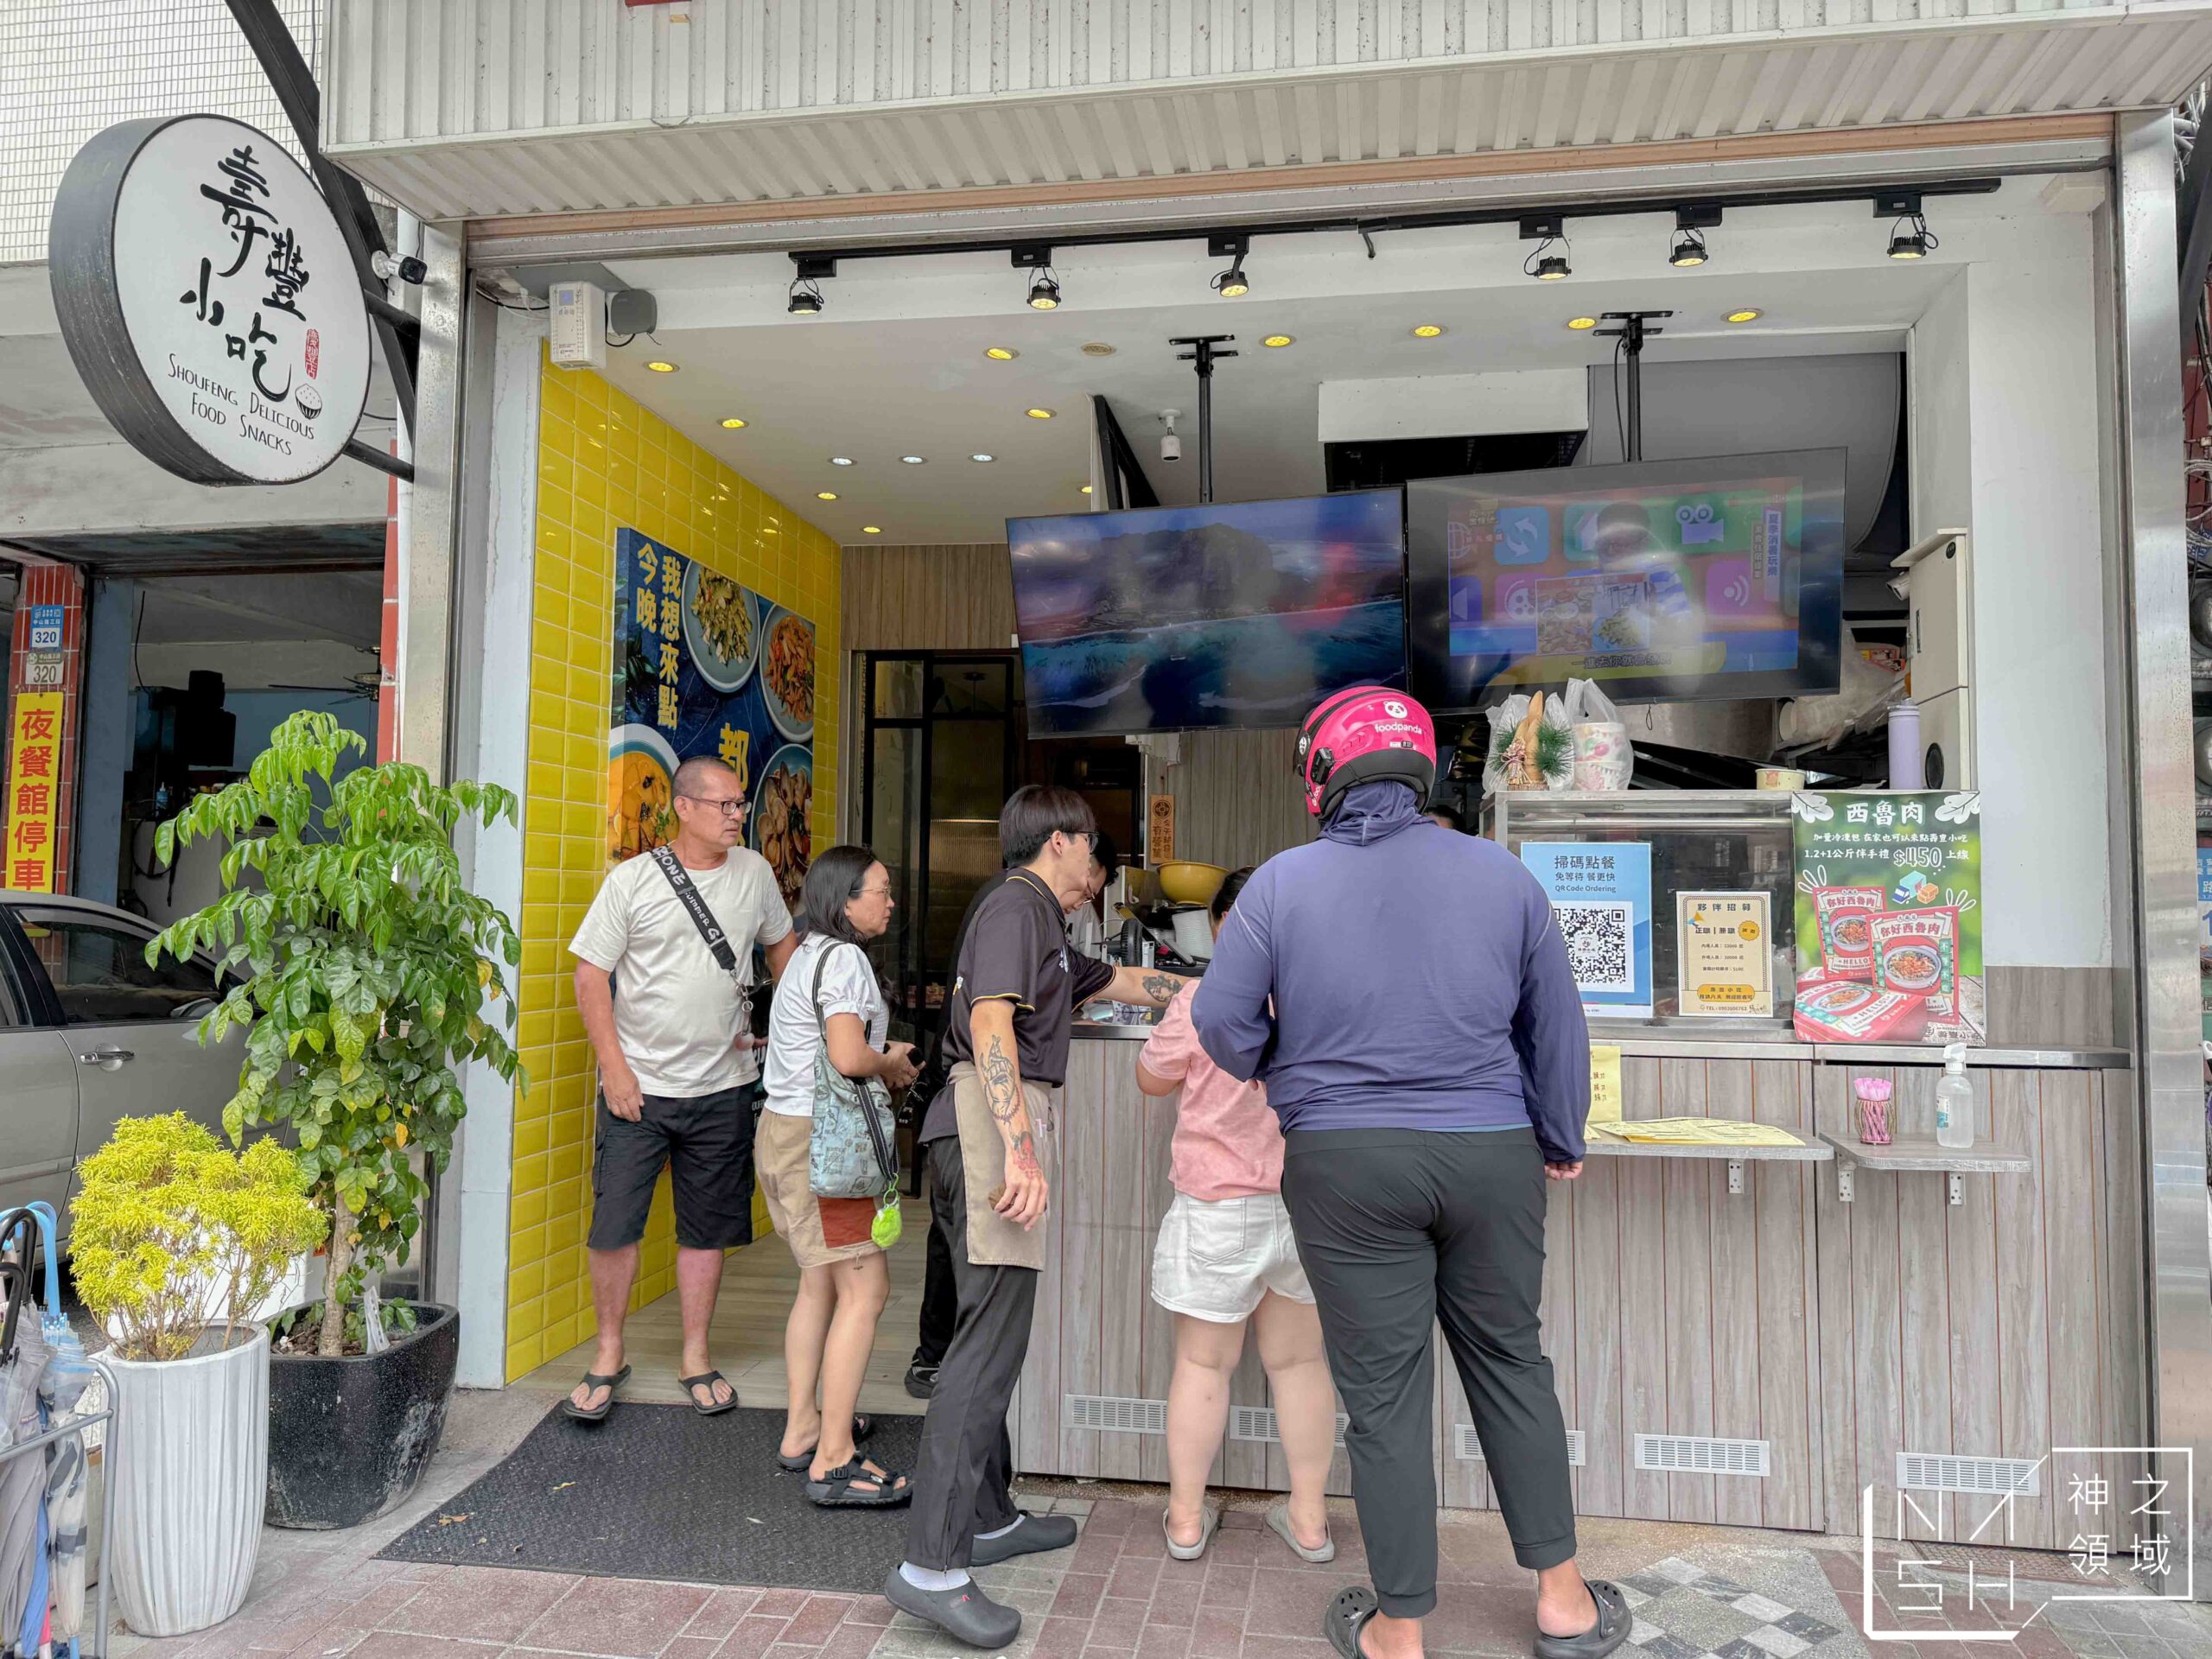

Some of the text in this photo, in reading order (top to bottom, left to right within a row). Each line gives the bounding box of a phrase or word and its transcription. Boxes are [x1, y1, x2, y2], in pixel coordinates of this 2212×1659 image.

[635, 542, 658, 635] 今晚
[35, 631, 58, 645] 320
[657, 555, 683, 732] 我想來點
[33, 665, 57, 683] 320
[1374, 721, 1423, 735] foodpanda
[12, 709, 56, 891] 夜餐館停車
[1846, 799, 1924, 826] 西魯肉
[1554, 855, 1616, 869] 掃碼點餐
[1892, 846, 1942, 868] $450
[1554, 872, 1616, 881] 免等待 餐更快
[1585, 884, 1617, 893] Ordering
[1880, 921, 1941, 938] 你好西魯肉
